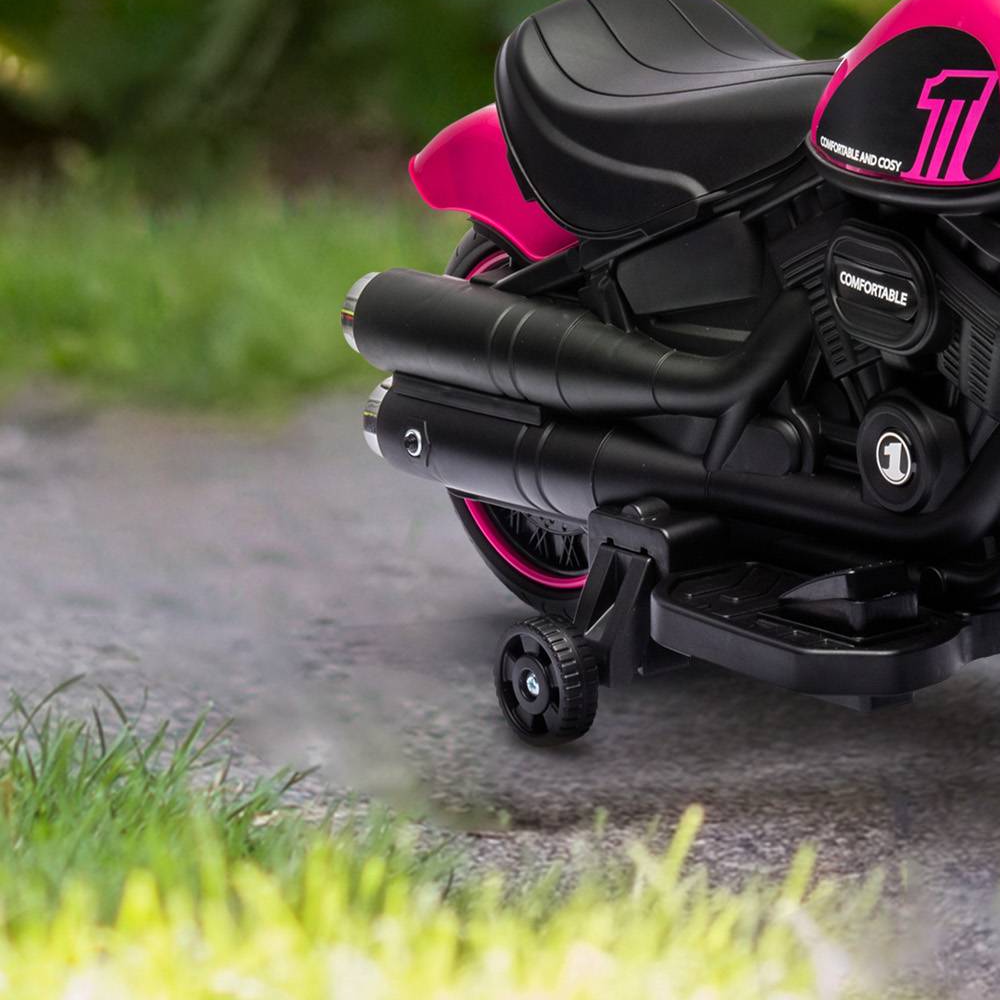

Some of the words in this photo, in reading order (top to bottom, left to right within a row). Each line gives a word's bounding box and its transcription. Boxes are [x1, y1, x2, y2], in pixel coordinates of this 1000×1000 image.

[820, 136, 860, 161] COMFORTABLE
[859, 151, 877, 166] AND
[877, 156, 903, 173] COSY
[839, 271, 908, 306] COMFORTABLE
[882, 442, 906, 481] 1
